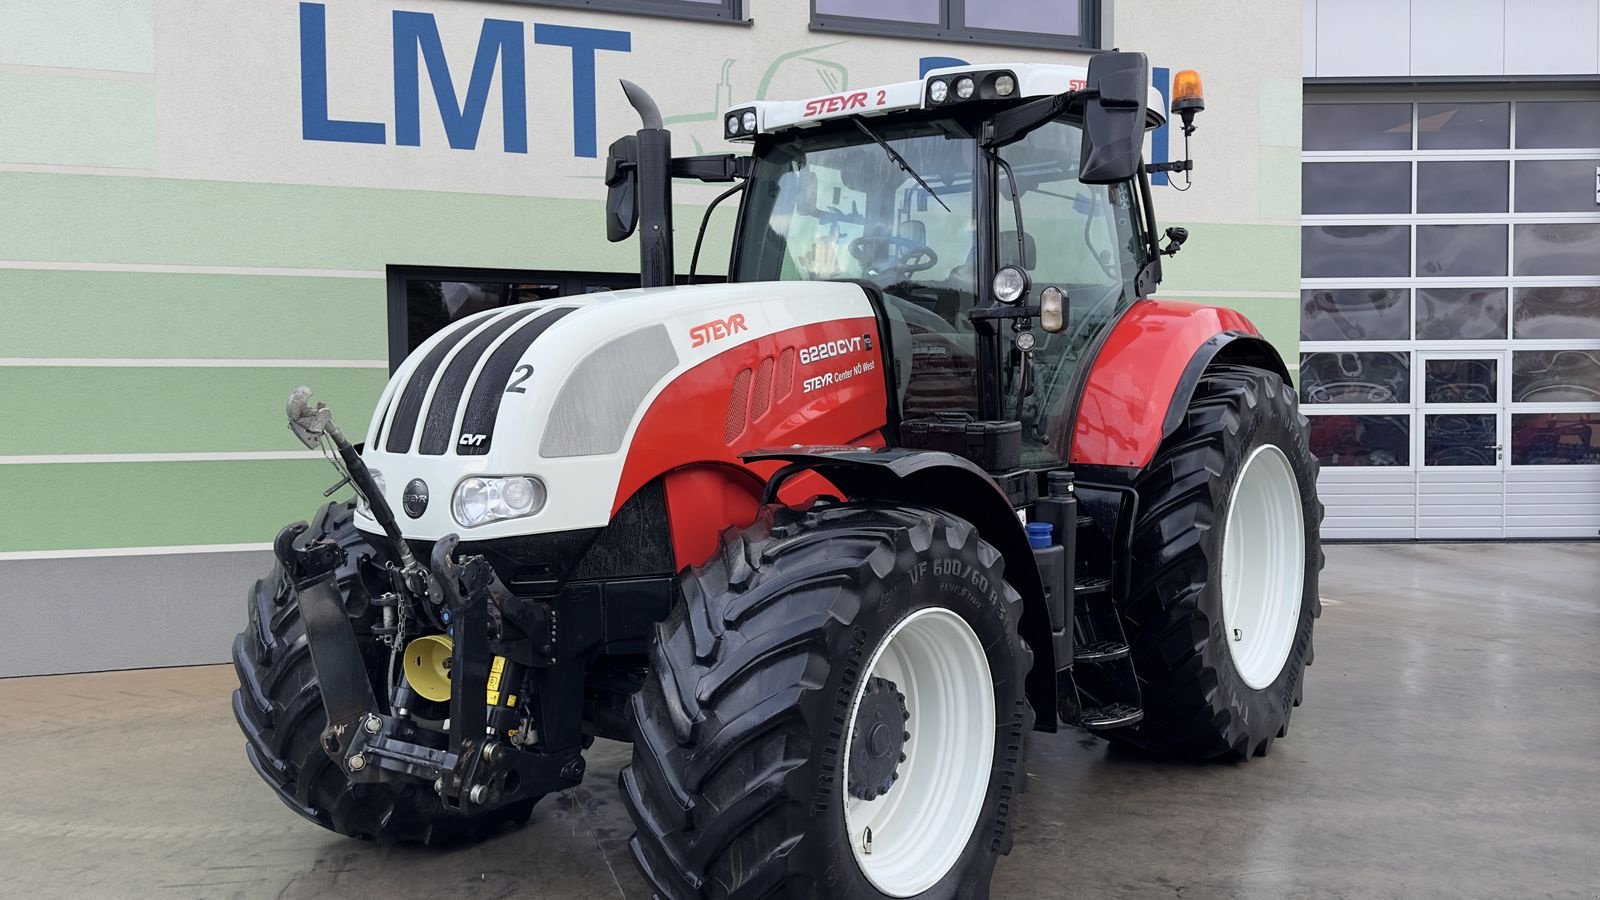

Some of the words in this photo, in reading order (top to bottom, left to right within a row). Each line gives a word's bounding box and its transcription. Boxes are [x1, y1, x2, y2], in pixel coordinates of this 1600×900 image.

[300, 2, 631, 158] LMT
[803, 91, 868, 117] STEYR
[876, 90, 886, 106] 2
[689, 313, 748, 348] STEYR
[800, 336, 861, 365] 6220CVT
[506, 364, 534, 394] 2
[803, 372, 833, 393] STEYR
[834, 370, 853, 382] Center
[853, 363, 862, 375] NÖ
[863, 360, 875, 372] West
[459, 433, 487, 446] CVT
[404, 494, 427, 504] STEYR
[907, 560, 928, 585] VF
[932, 558, 989, 594] 600/60
